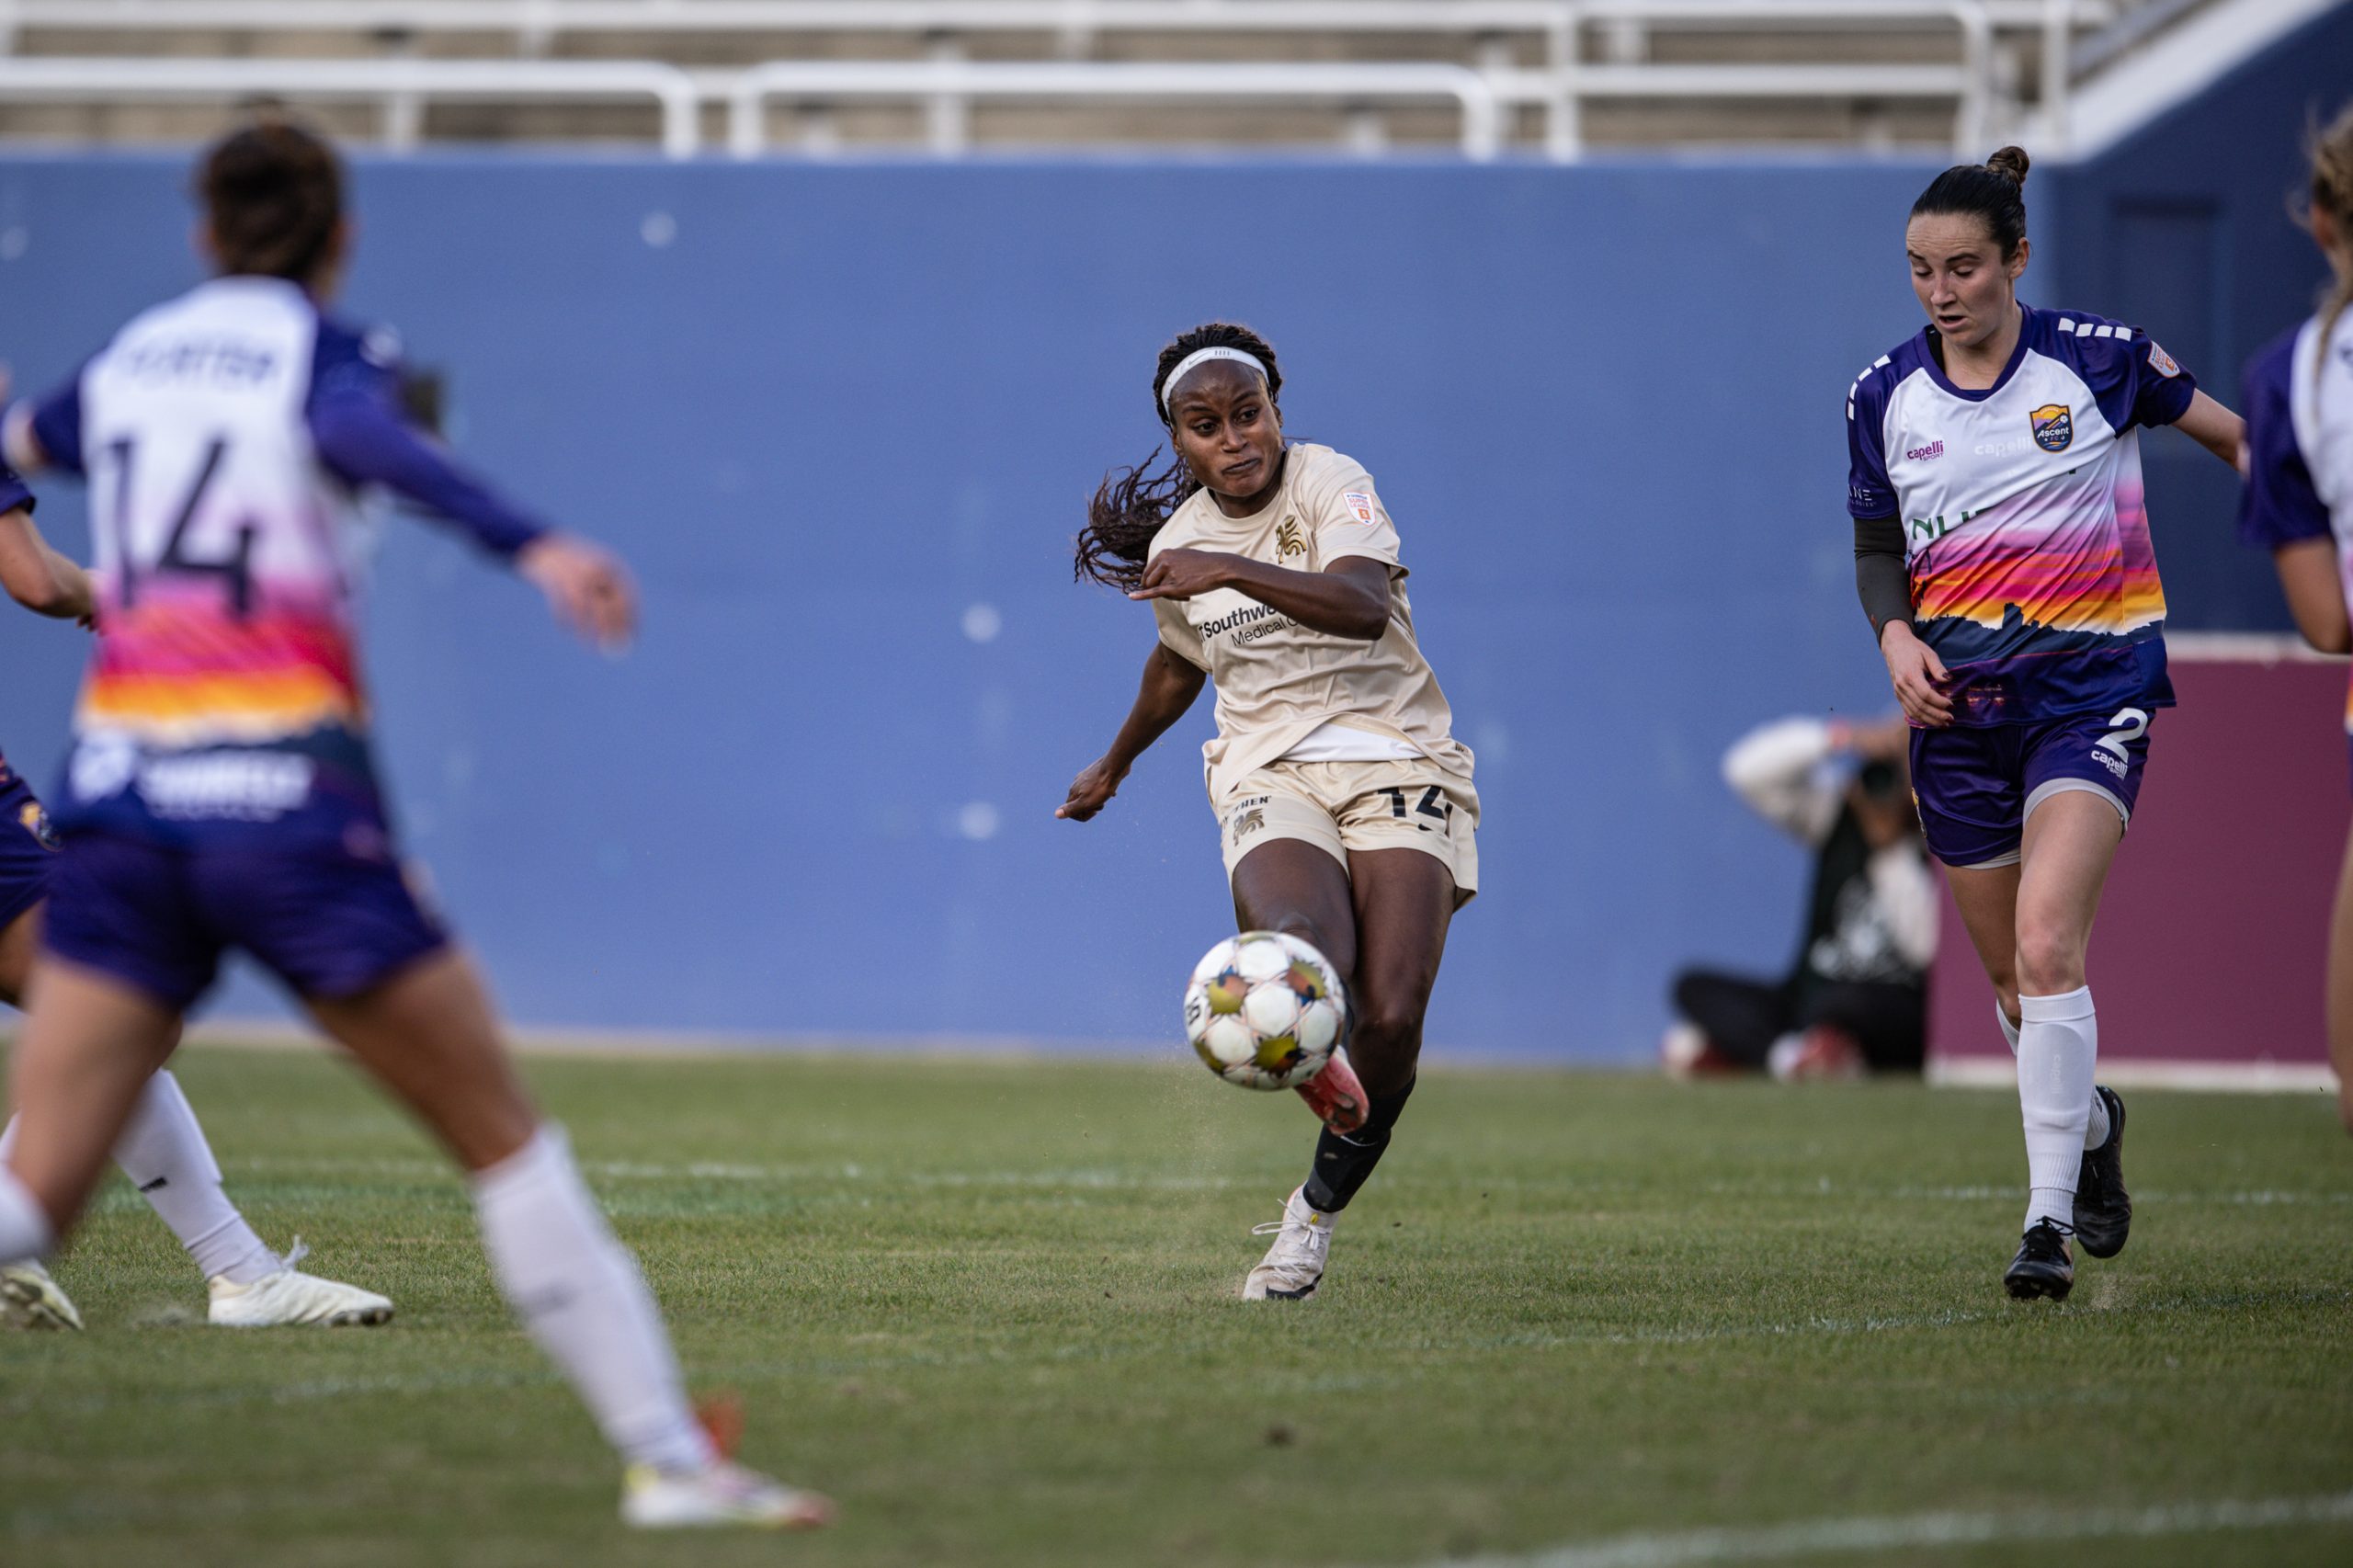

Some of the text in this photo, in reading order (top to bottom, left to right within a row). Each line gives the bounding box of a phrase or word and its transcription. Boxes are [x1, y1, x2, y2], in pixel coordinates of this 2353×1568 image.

[2037, 426, 2069, 438] Ascent
[1907, 440, 1944, 460] capelli
[108, 437, 257, 621] 14
[1204, 605, 1277, 639] Southwe
[1232, 618, 1286, 646] Medical
[2095, 707, 2148, 764] 2
[2091, 750, 2129, 776] capelli
